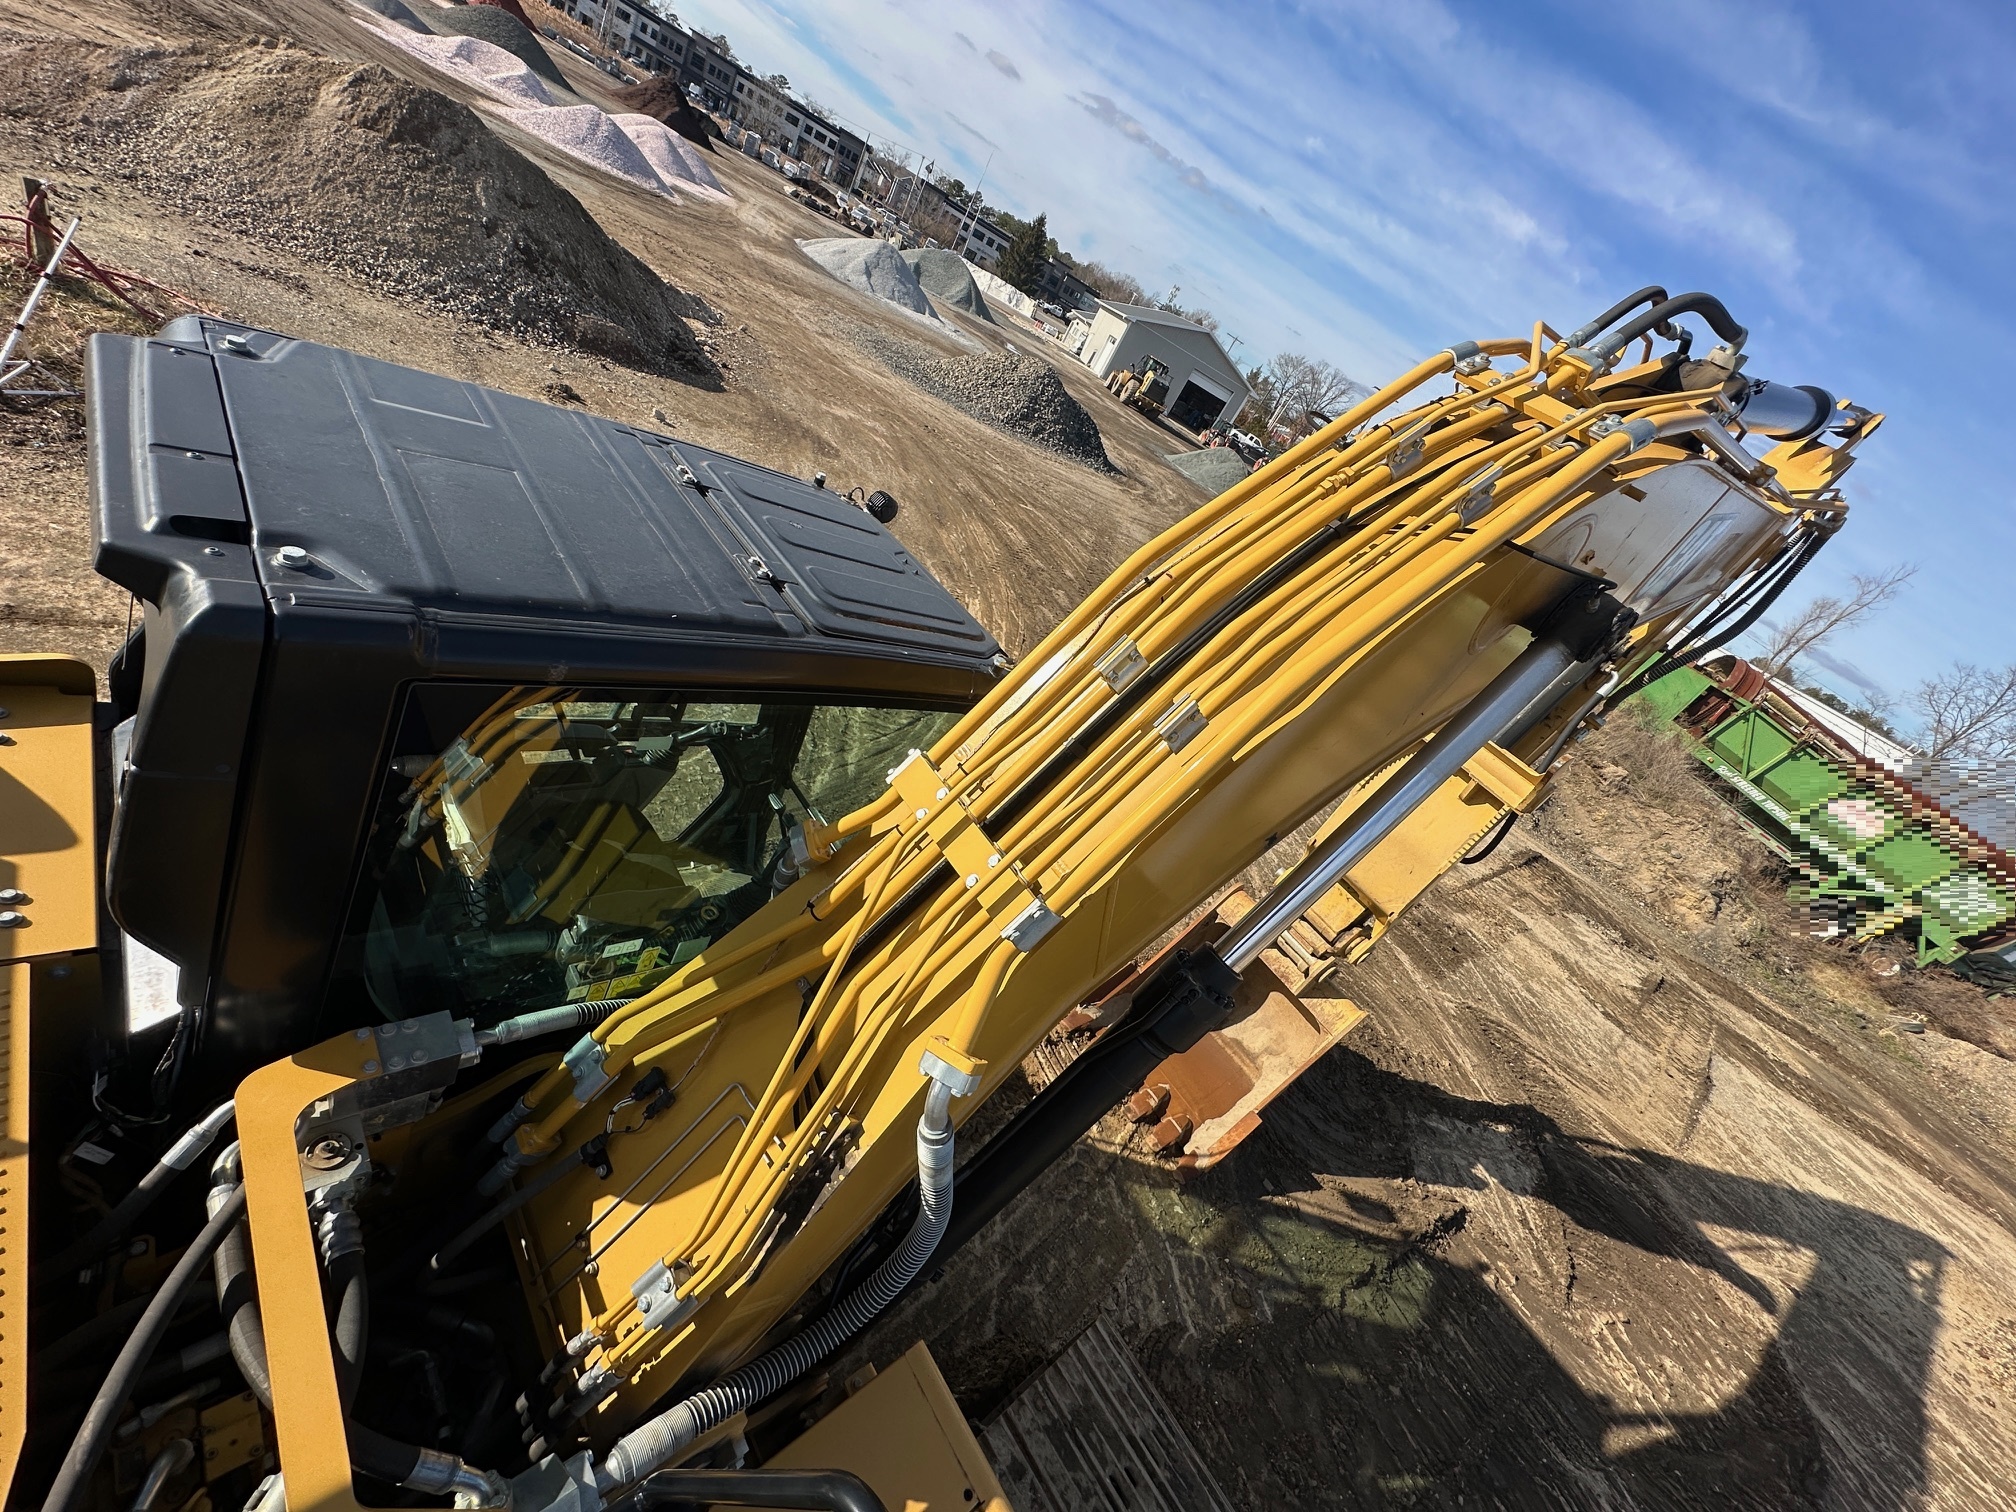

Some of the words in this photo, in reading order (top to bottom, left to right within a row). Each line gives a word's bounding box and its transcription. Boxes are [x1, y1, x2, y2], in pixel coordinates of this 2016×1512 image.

[1633, 518, 1736, 602] CAT
[1730, 776, 1767, 801] SCREENED
[1761, 799, 1791, 822] TOPSOIL
